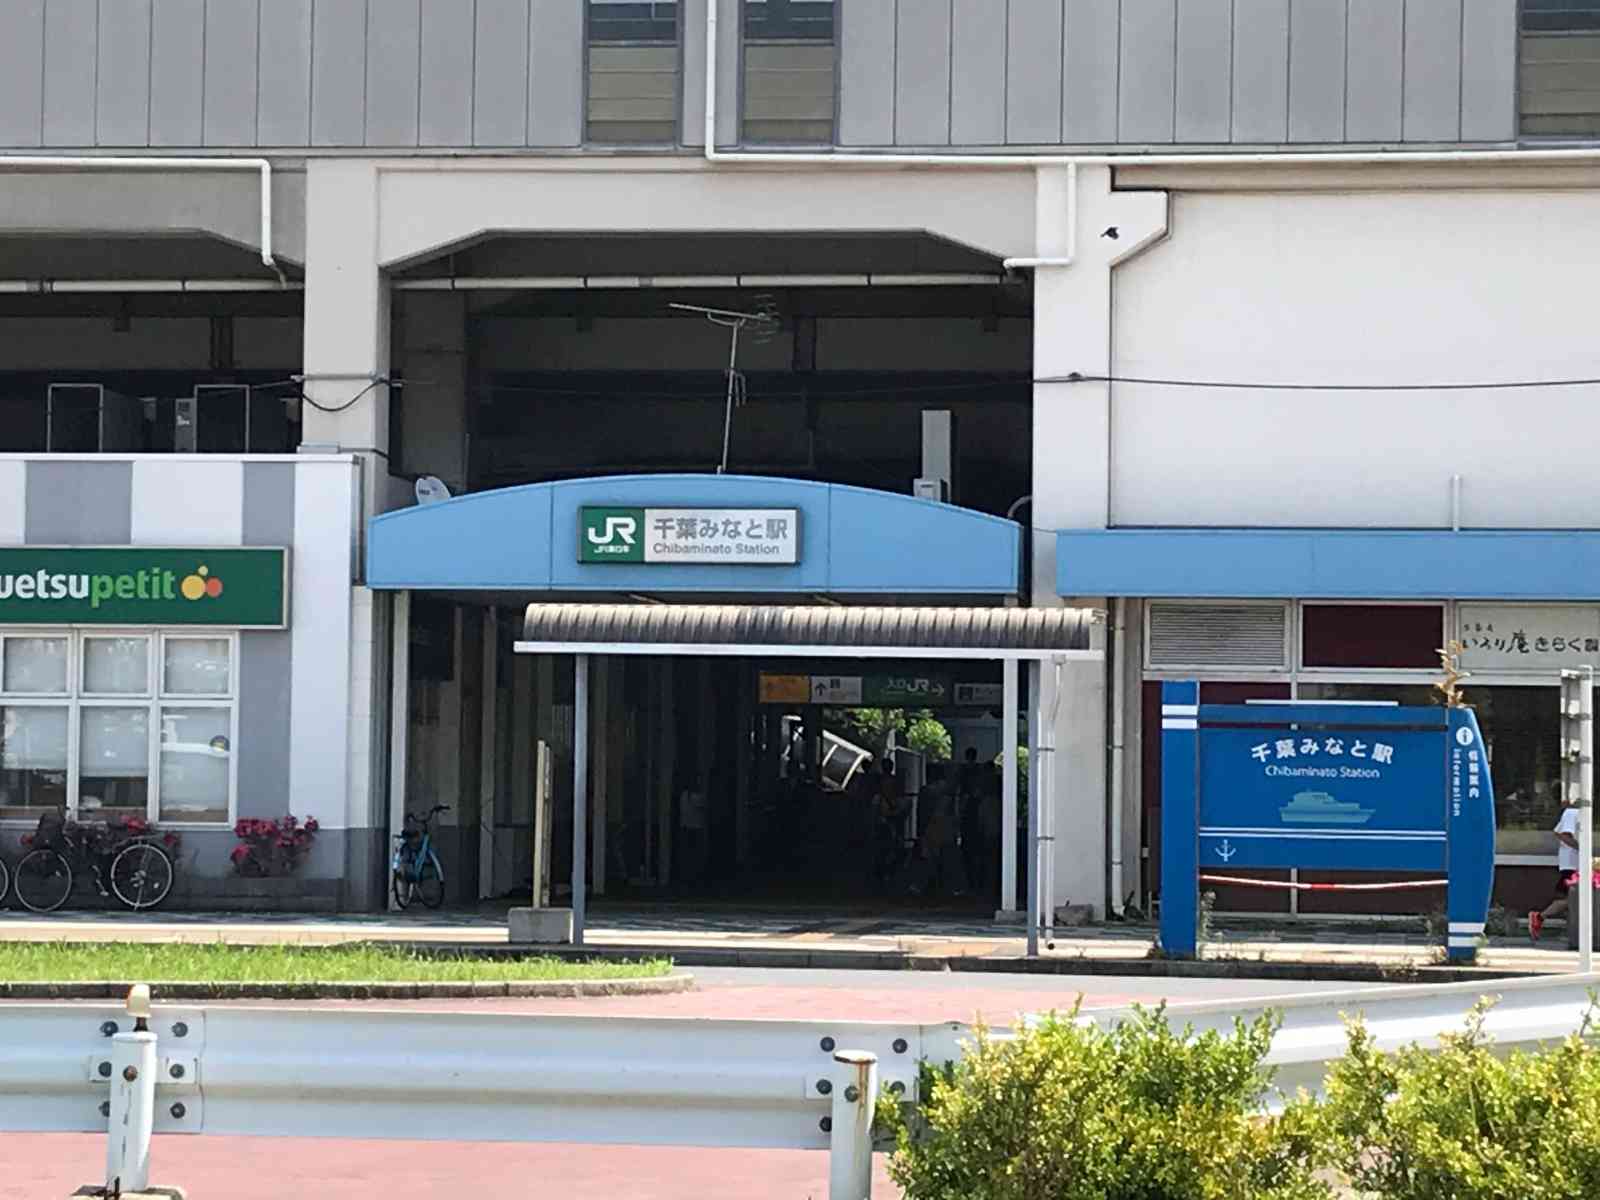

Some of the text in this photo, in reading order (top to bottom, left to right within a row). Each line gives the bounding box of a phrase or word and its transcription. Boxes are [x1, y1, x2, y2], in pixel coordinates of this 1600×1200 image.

[588, 517, 636, 544] JR
[654, 518, 788, 540] 千葉みなと駅
[653, 543, 779, 555] Chibaminato Station
[1251, 737, 1394, 765] 千葉みなと駅
[1265, 765, 1380, 778] Chibaminato Station
